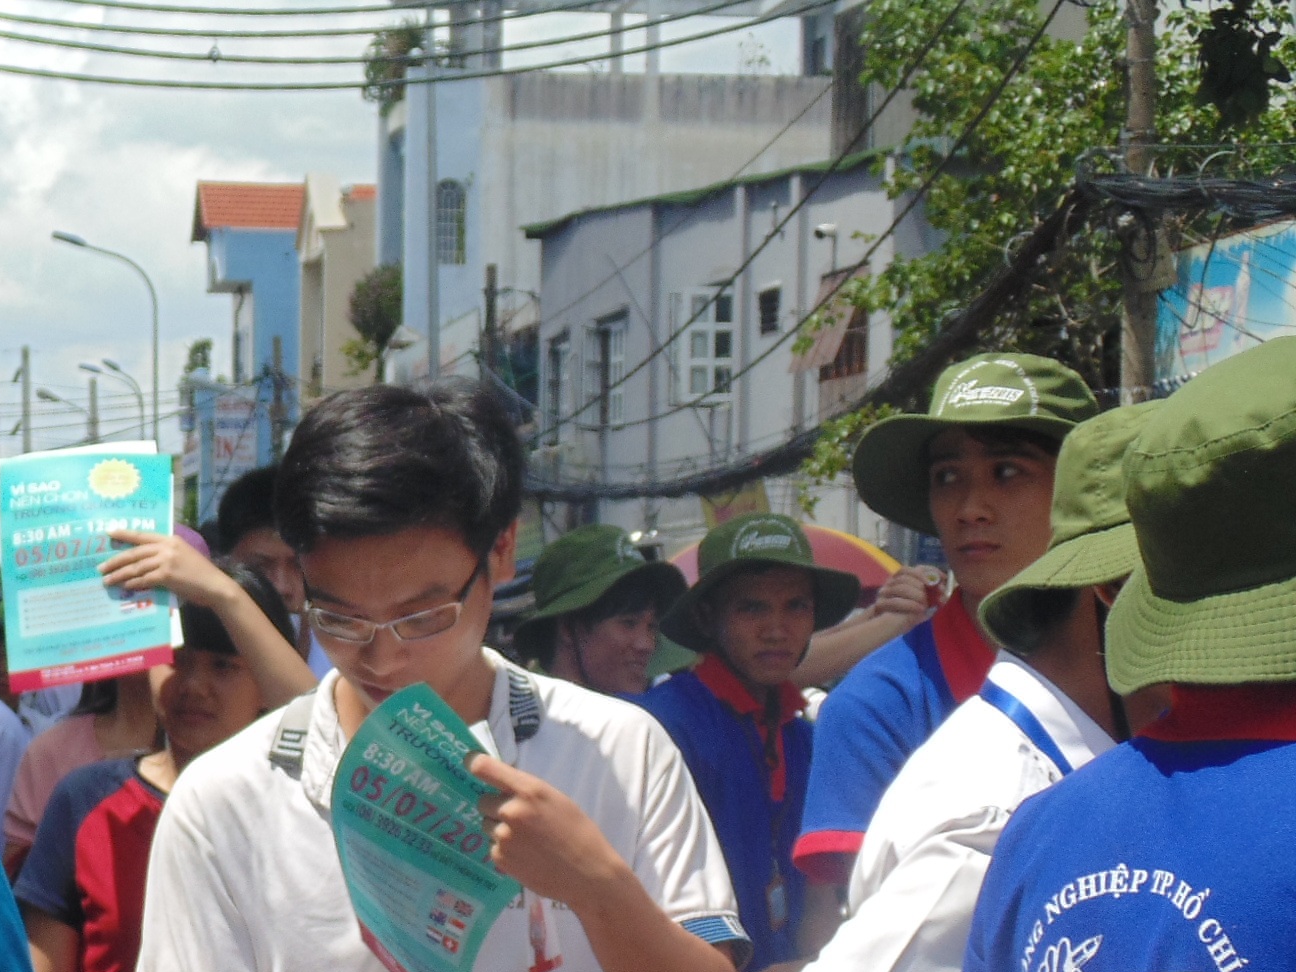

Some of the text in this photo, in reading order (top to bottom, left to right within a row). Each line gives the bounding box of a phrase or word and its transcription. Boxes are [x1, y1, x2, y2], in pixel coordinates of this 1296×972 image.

[27, 479, 61, 493] SAO
[13, 528, 44, 546] 8:30
[47, 524, 71, 540] AM
[131, 518, 156, 531] PM
[15, 534, 109, 567] 05/07/2
[362, 742, 407, 776] 8:30
[403, 769, 442, 796] AM
[1044, 863, 1149, 924] NGHIỆP
